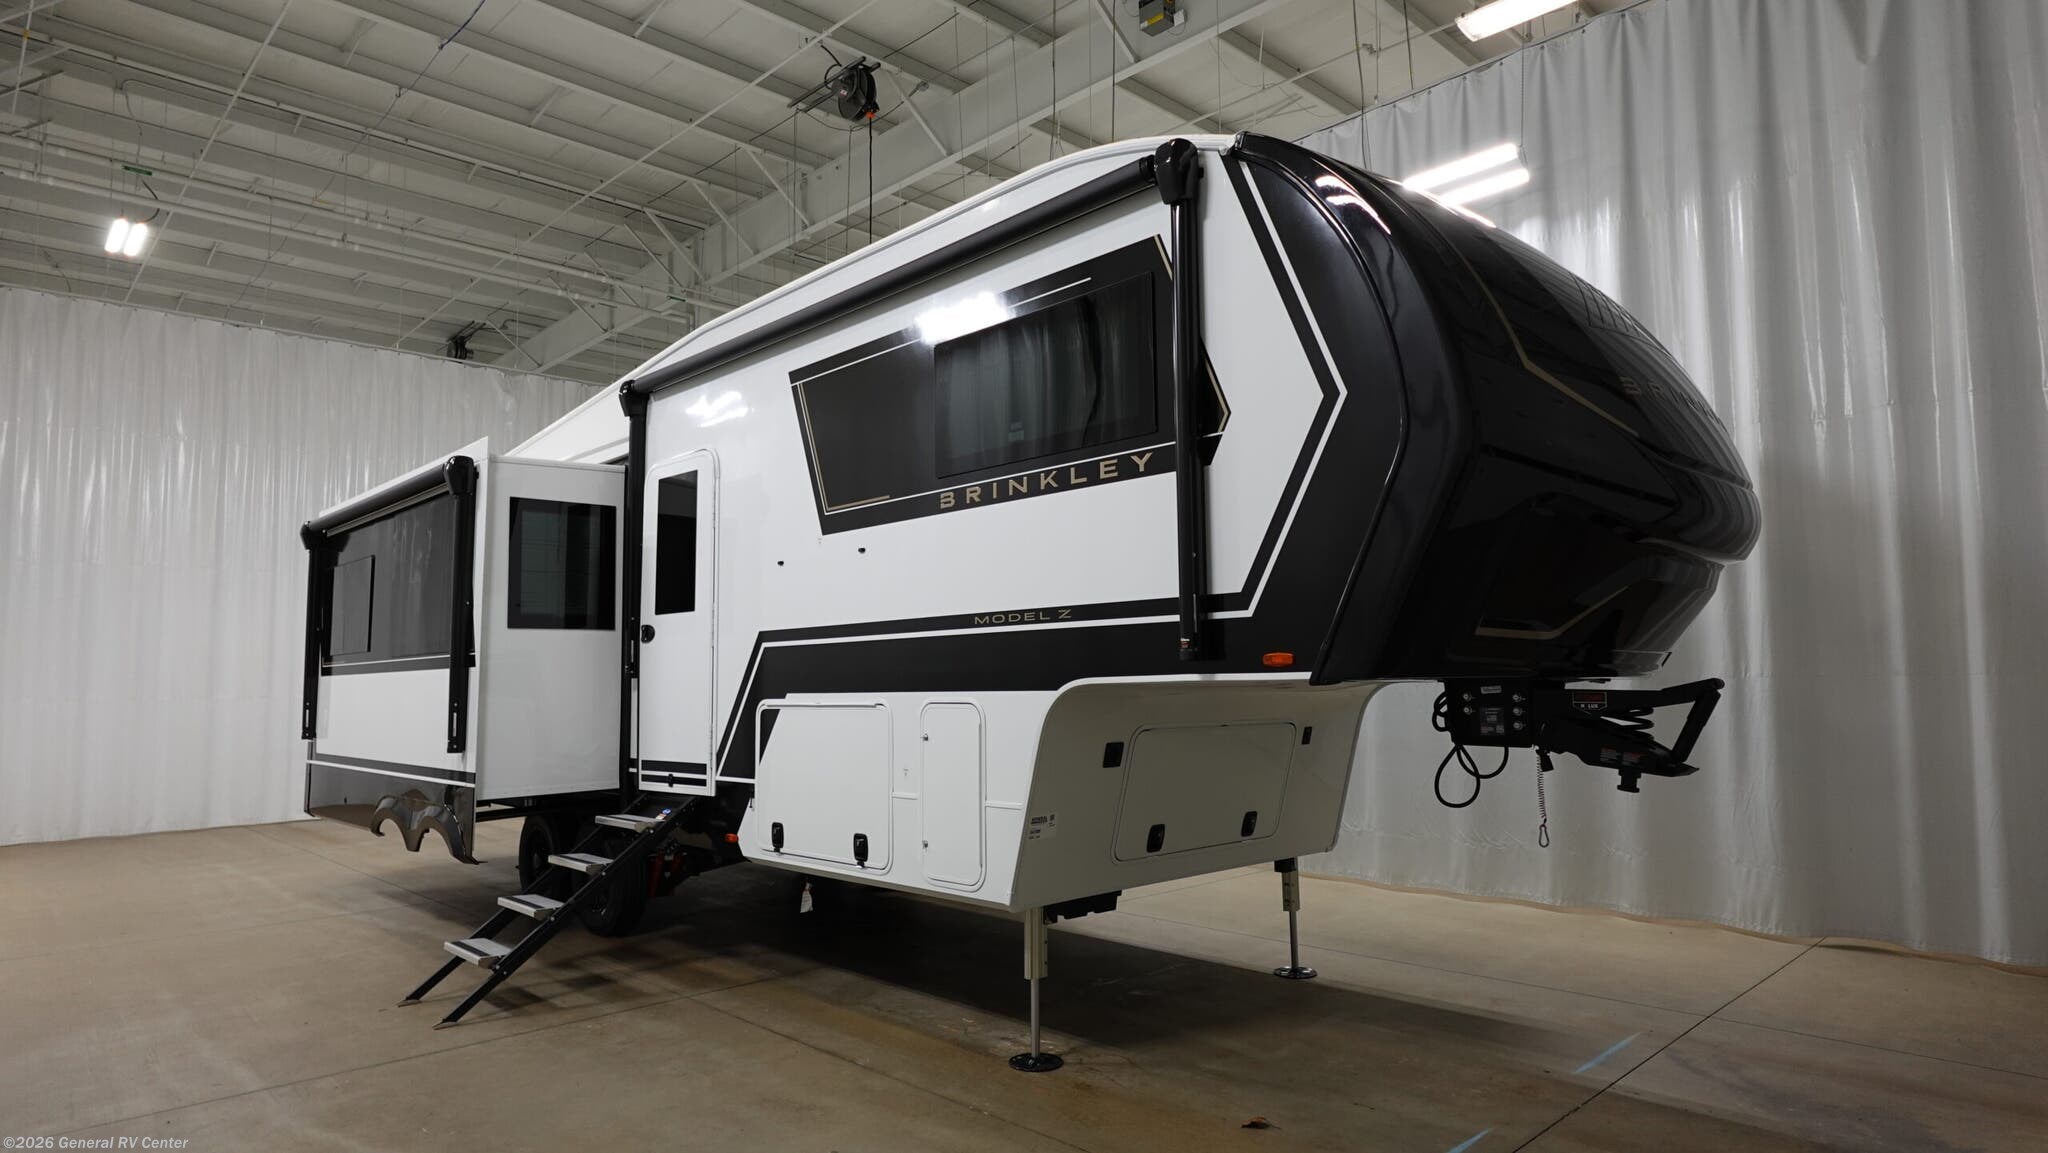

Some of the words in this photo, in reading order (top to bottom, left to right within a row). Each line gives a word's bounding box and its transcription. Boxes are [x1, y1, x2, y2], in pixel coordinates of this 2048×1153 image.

[940, 452, 1153, 509] BRINKLEY
[974, 611, 1050, 625] MODEL
[1058, 608, 1072, 620] Z
